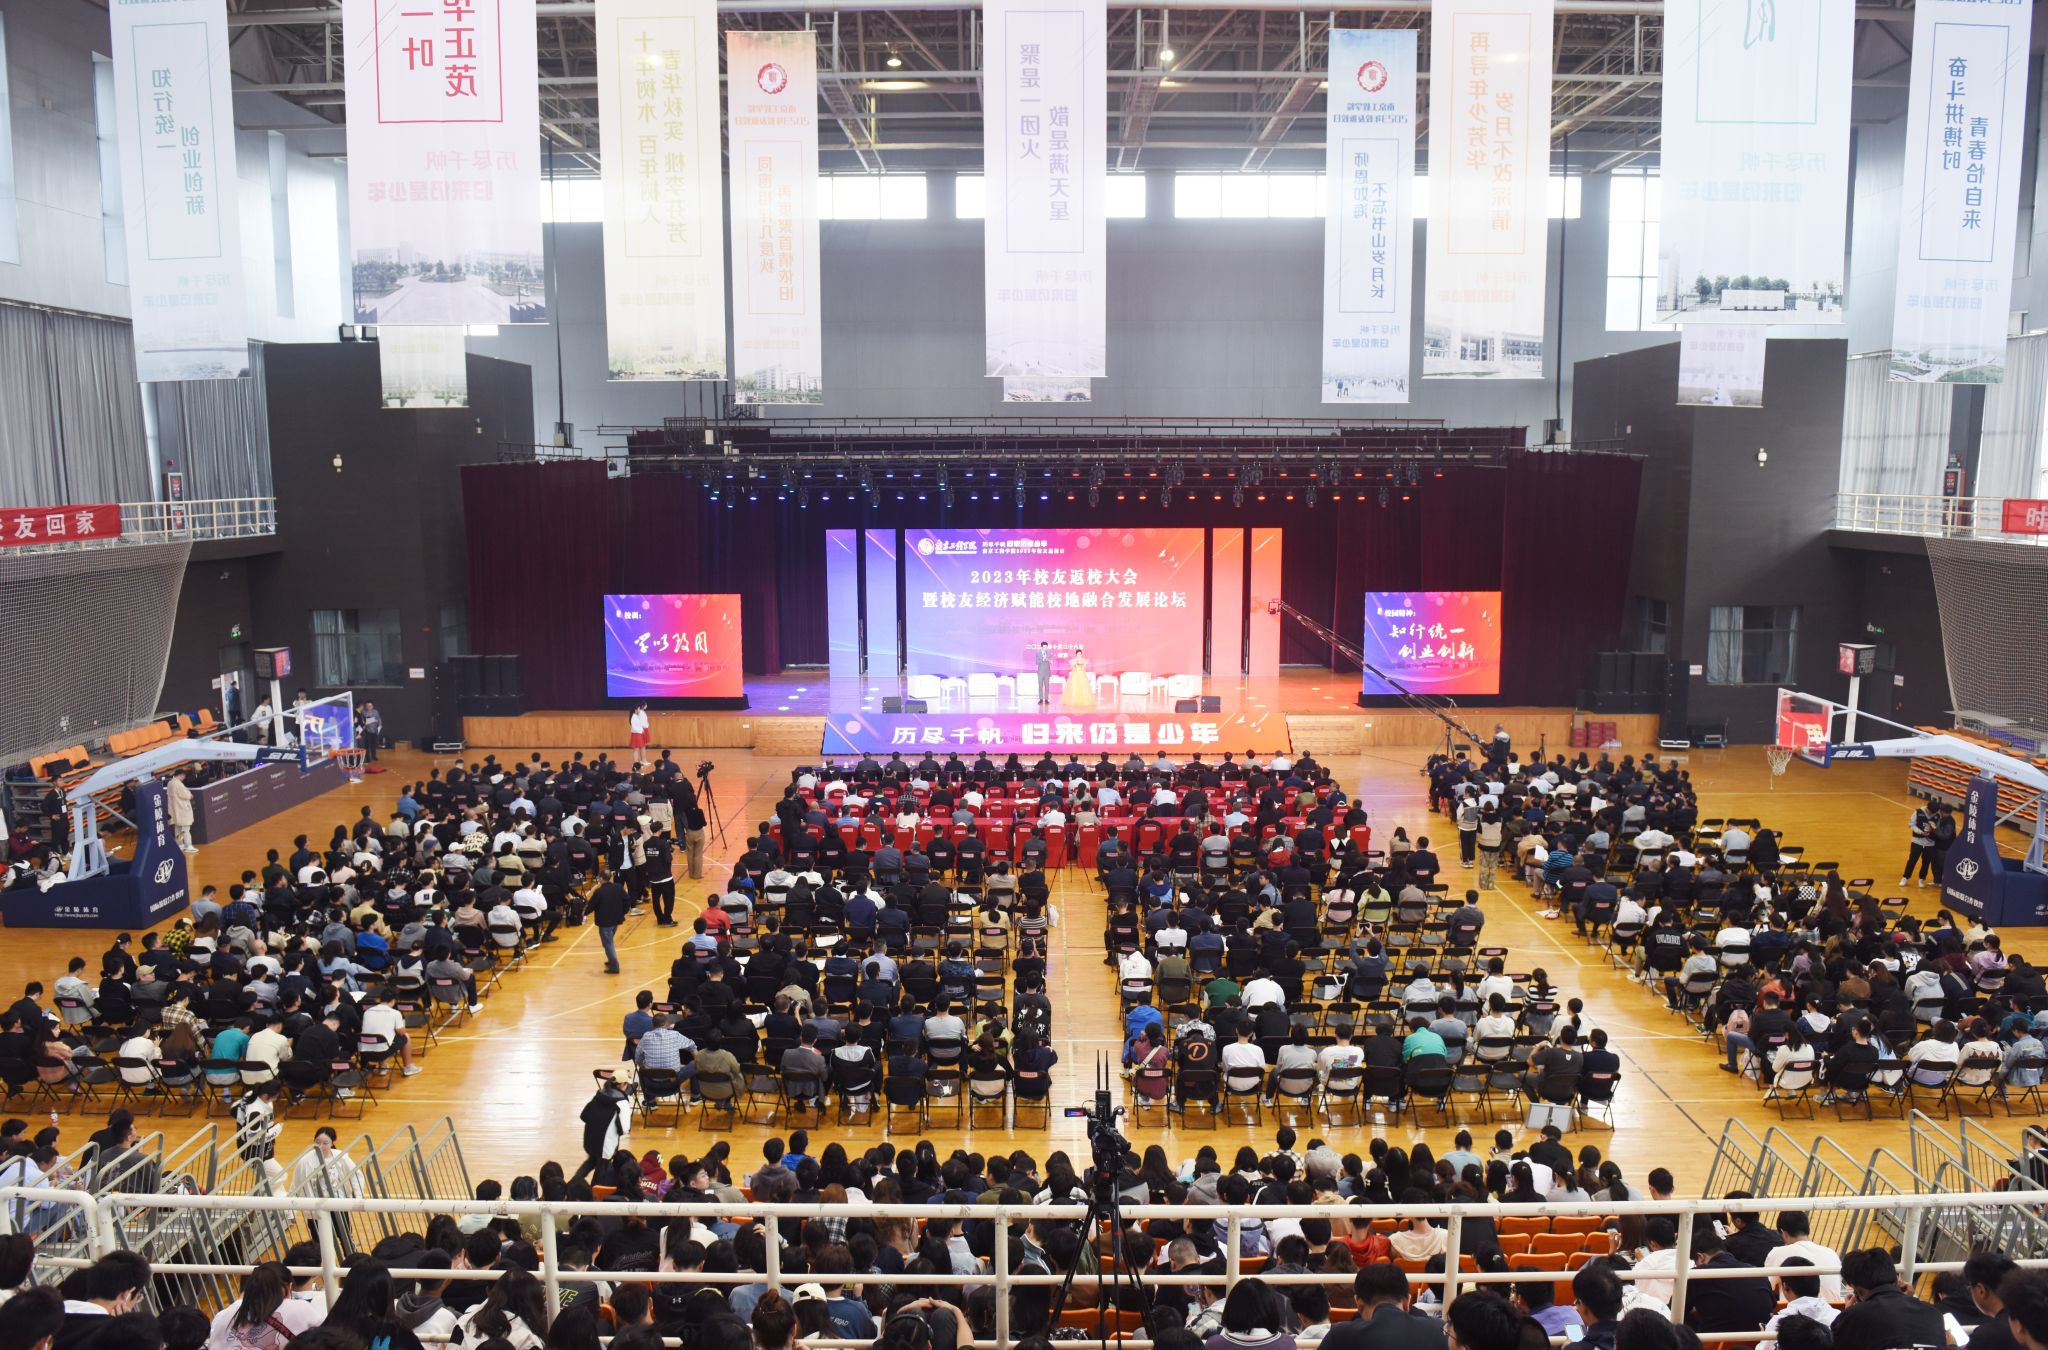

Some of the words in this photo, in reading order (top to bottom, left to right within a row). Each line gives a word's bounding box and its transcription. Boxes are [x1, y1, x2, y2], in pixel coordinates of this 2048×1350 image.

[0, 511, 95, 540] 友回家
[970, 567, 1139, 586] 2023年校友返校大会
[922, 591, 1187, 608] 暨校友经济赋能校地融合发展论坛
[1388, 622, 1466, 640] 知行统一
[1397, 640, 1475, 661] 创业创新
[891, 726, 1005, 745] 历尽千帆
[1019, 723, 1220, 745] 归来仍是少年
[153, 794, 167, 848] 金陵体育
[1966, 790, 1980, 845] 金陵体育
